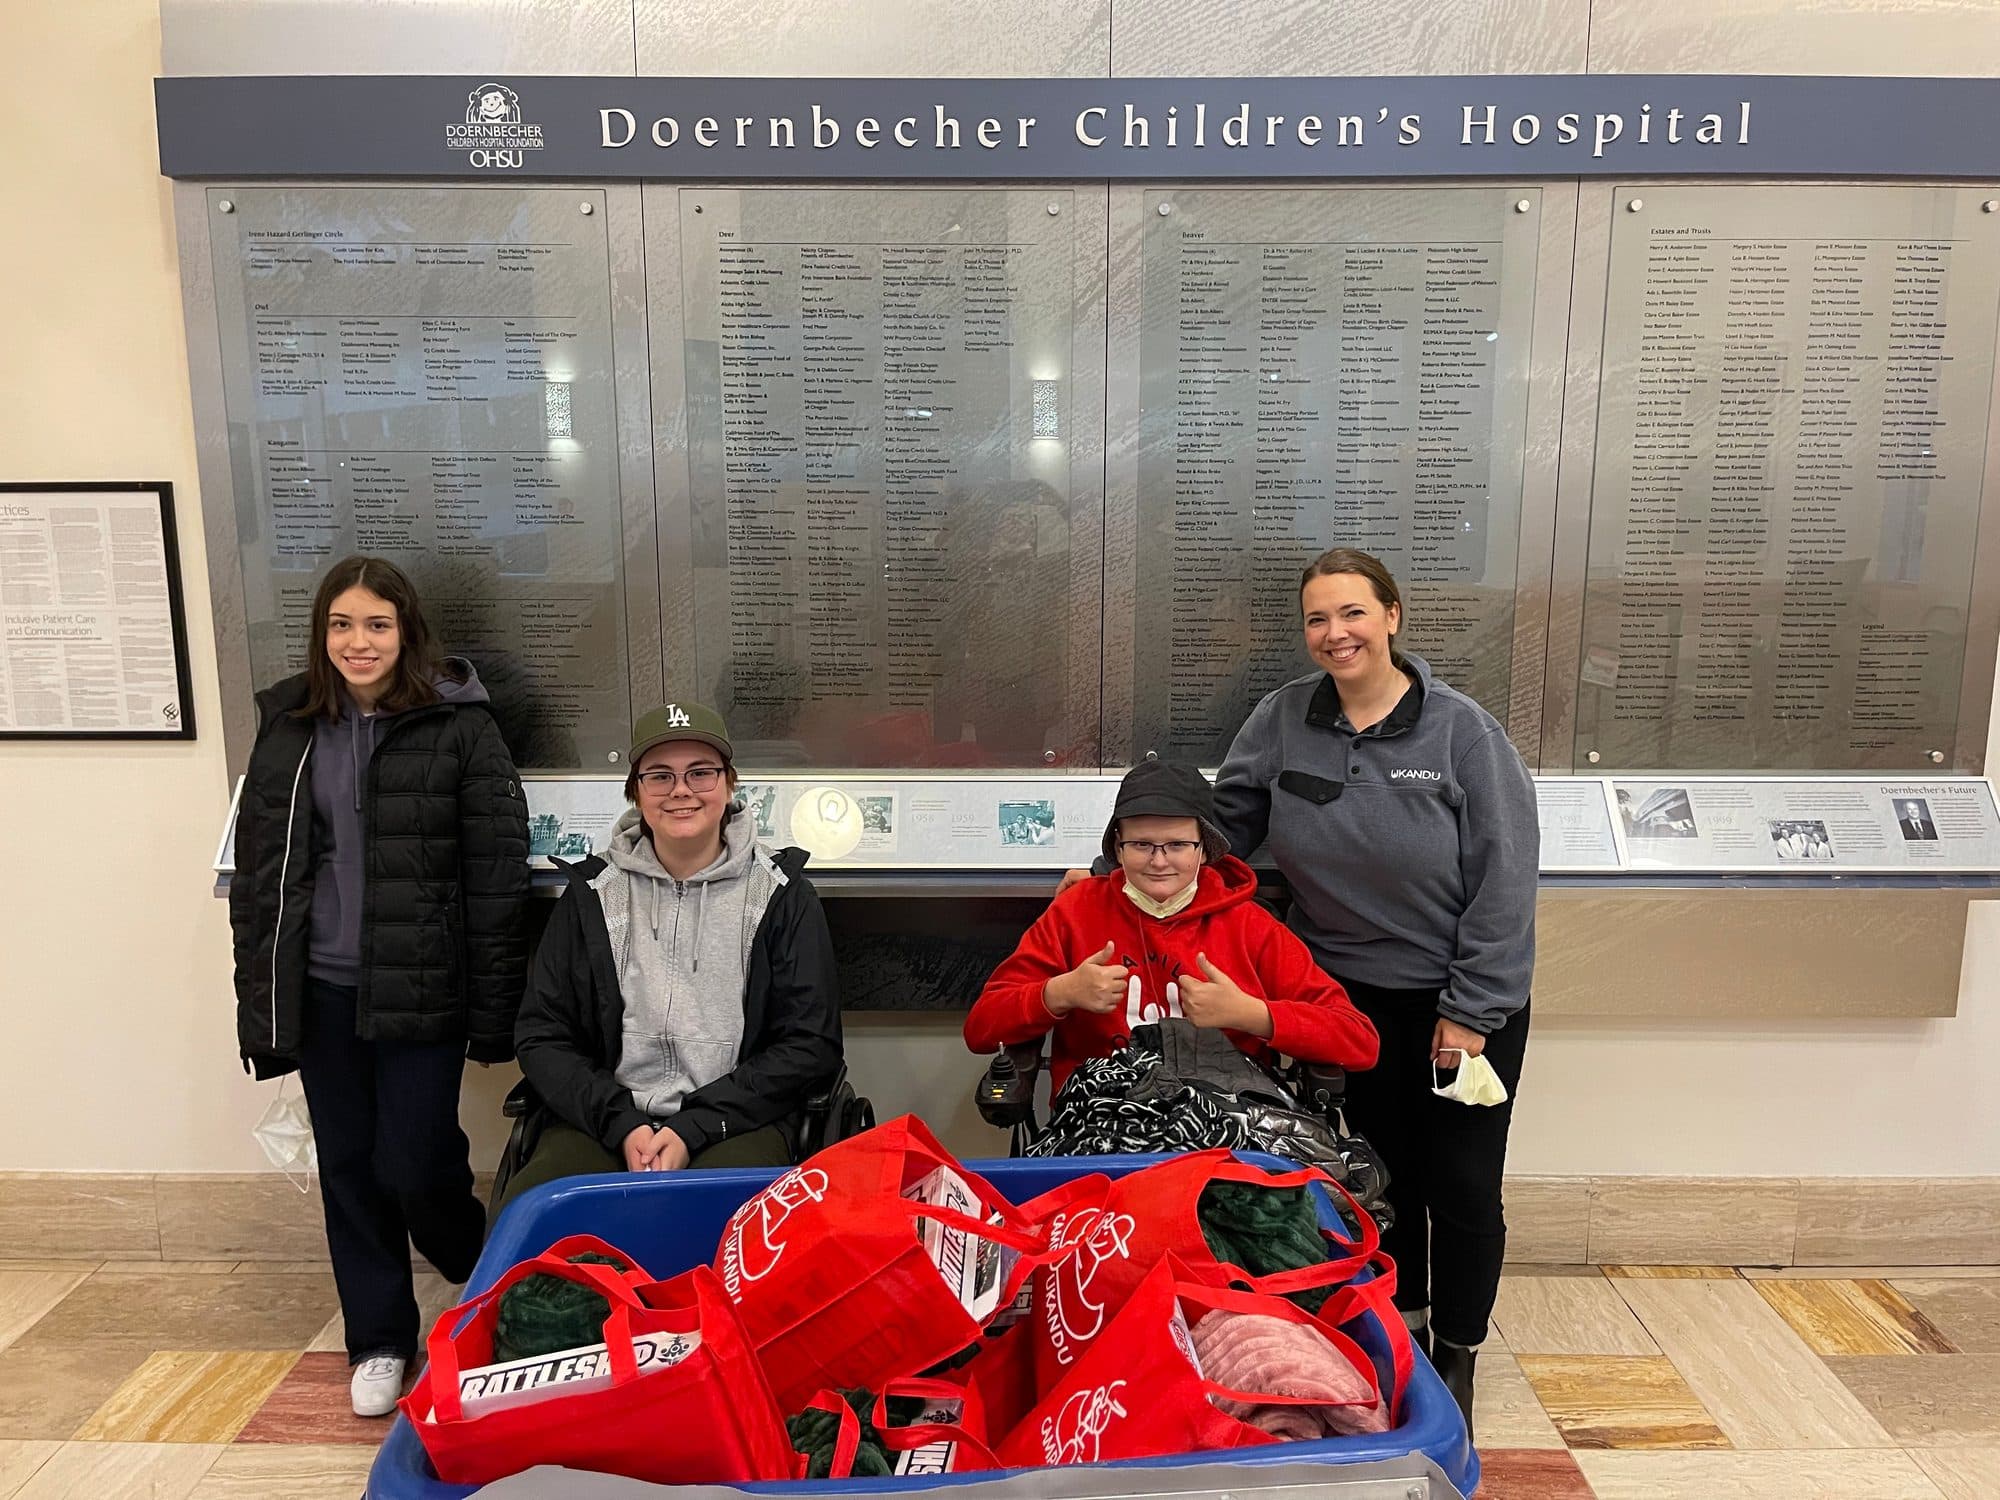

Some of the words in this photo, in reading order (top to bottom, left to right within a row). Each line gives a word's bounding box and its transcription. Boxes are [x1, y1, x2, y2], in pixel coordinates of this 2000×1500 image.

[446, 125, 543, 137] DOERNBECHER
[600, 104, 1036, 149] Doernbecher
[1460, 102, 1752, 157] Hospital
[506, 138, 544, 148] FOUNDATION
[469, 149, 523, 168] OHSU
[325, 230, 343, 238] Circle
[1183, 231, 1204, 239] Beaver
[1676, 227, 1689, 235] and
[5, 614, 41, 624] Inclusive
[43, 614, 73, 624] Patient
[75, 613, 96, 624] Care
[7, 626, 22, 636] and
[24, 625, 92, 636] Communication
[666, 703, 691, 728] LA
[1948, 786, 1977, 795] Future
[1045, 1273, 1074, 1365] UKANDU
